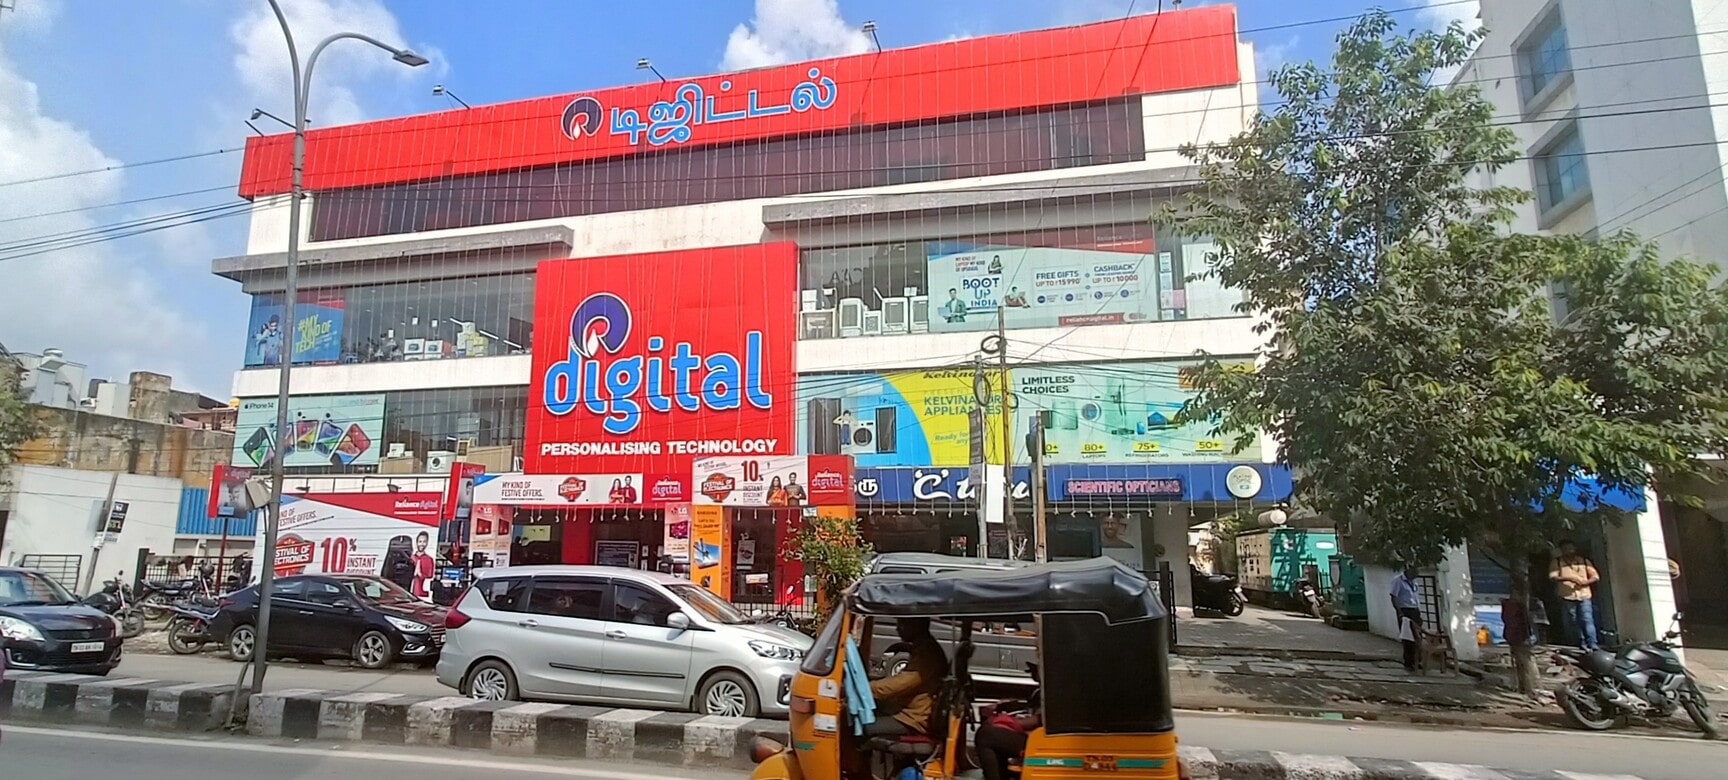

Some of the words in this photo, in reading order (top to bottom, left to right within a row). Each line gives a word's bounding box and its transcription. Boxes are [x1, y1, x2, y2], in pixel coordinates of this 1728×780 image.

[610, 67, 838, 146] டிஜிட்டல்
[1036, 272, 1056, 280] FREE
[1057, 270, 1079, 279] GIFTS
[963, 277, 1000, 289] BOOT
[975, 288, 991, 299] UP
[970, 299, 998, 307] INDIA
[543, 330, 772, 434] digital
[1022, 375, 1075, 385] LIMITLESS
[1022, 386, 1069, 394] CHOICES
[541, 441, 661, 456] PERSONALISING
[666, 439, 778, 455] TECHNOLOGY
[1084, 443, 1104, 451] 80+
[1199, 441, 1220, 449] 50+
[1068, 480, 1123, 493] SCIENTIFIC
[1125, 479, 1180, 493] OPTICIANS
[501, 489, 521, 497] FESTIVE
[279, 515, 296, 527] ESTIVE
[275, 547, 299, 558] STIVAL
[301, 545, 311, 554] OF
[347, 557, 376, 568] INSTANT
